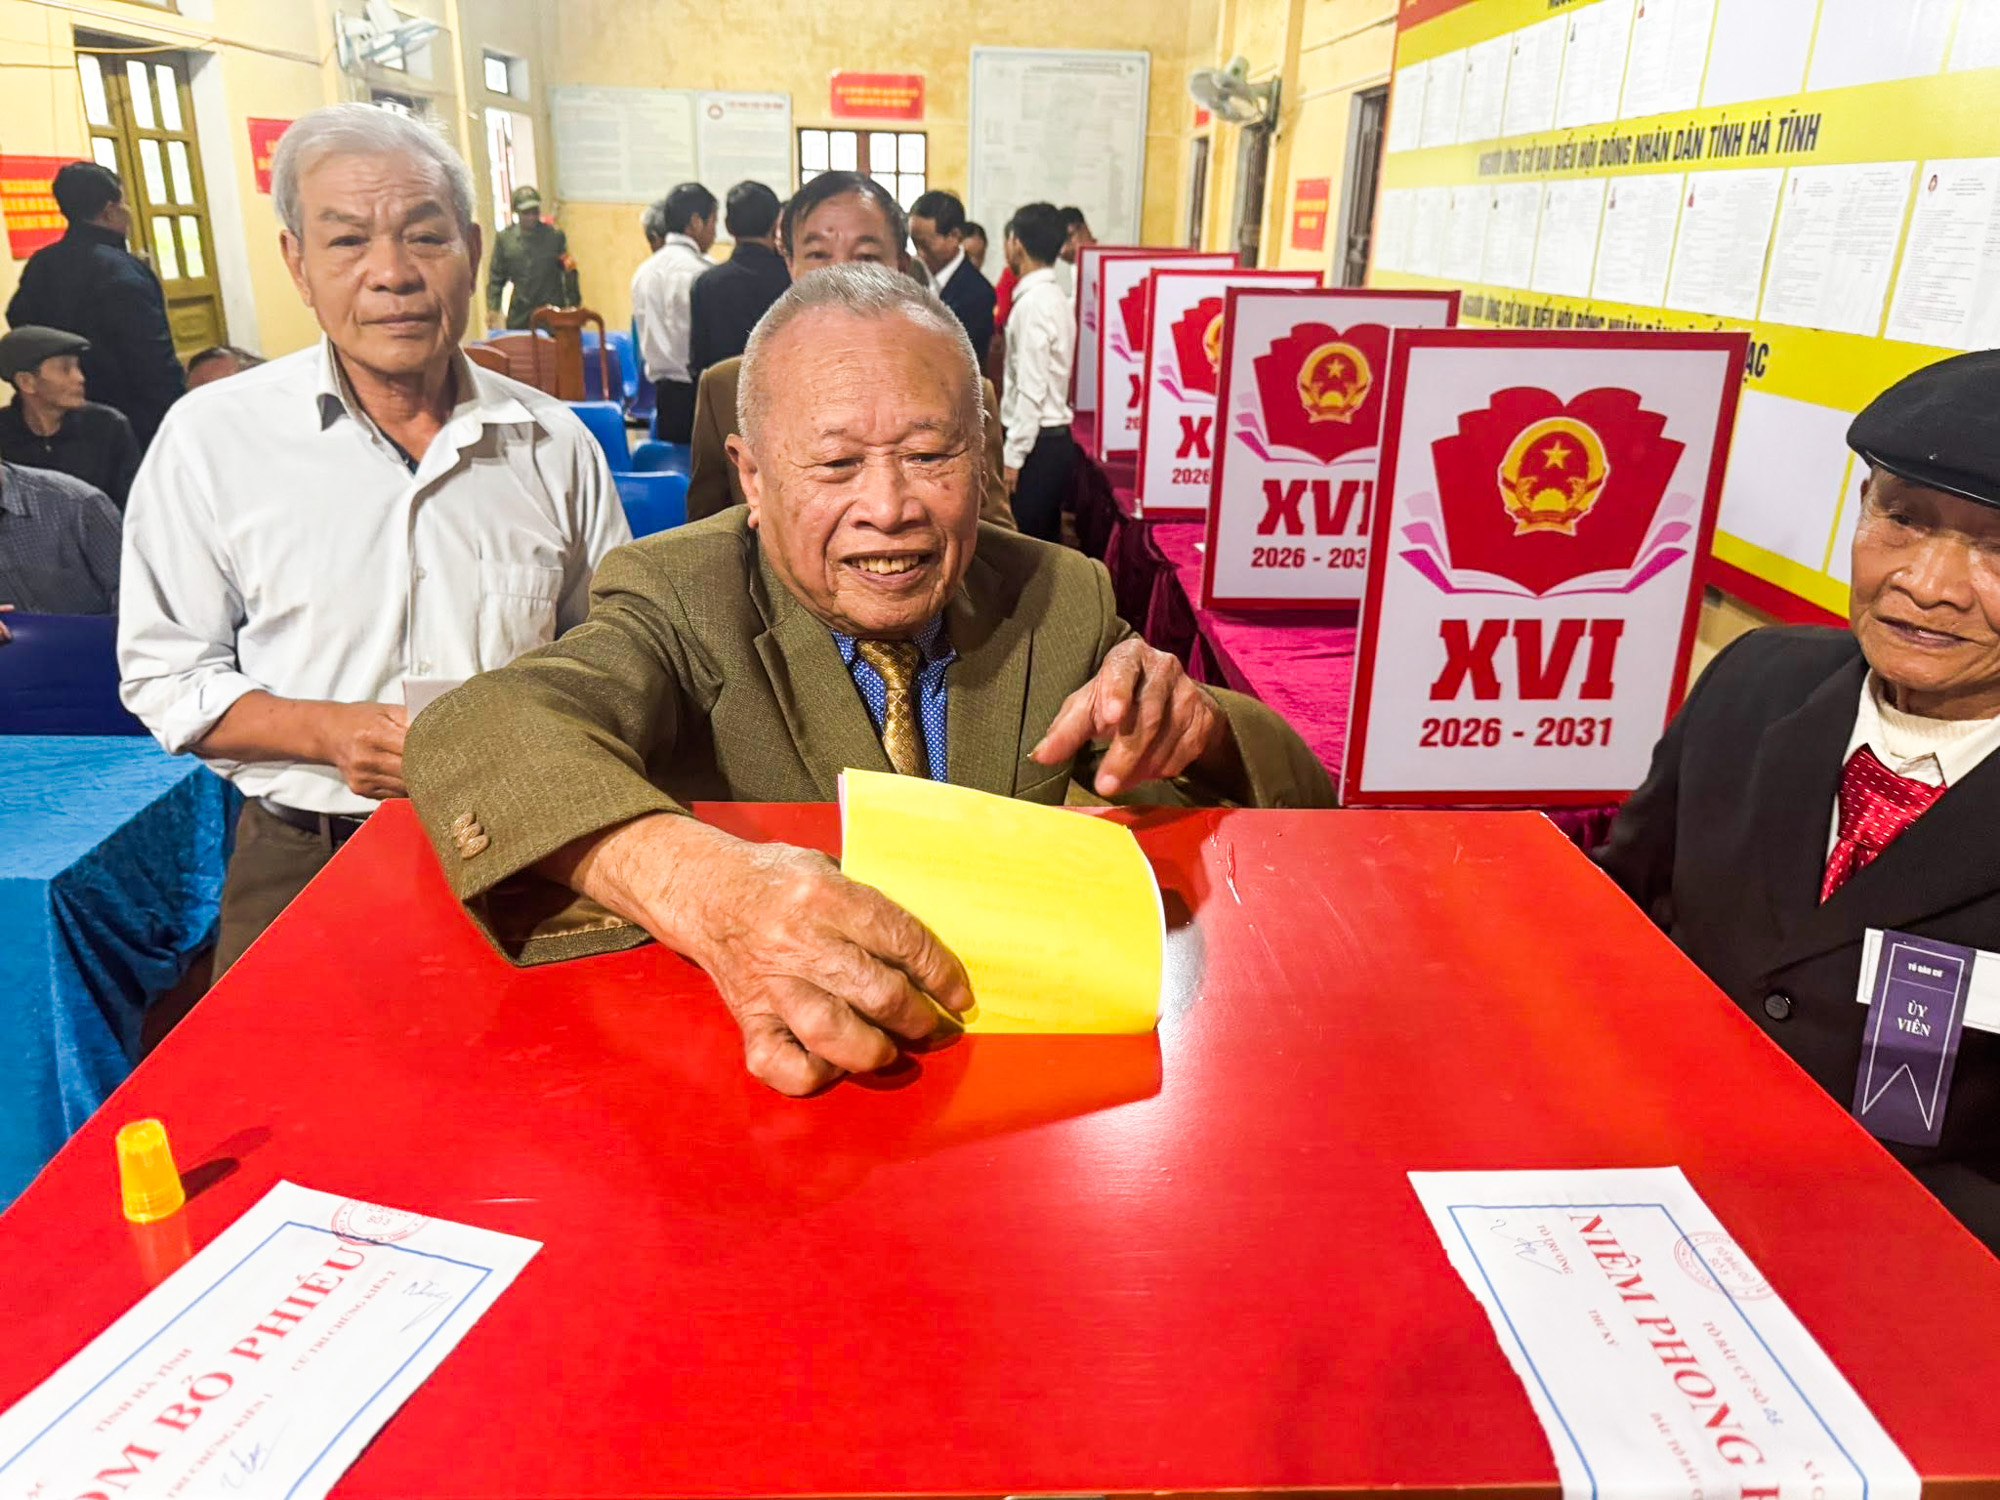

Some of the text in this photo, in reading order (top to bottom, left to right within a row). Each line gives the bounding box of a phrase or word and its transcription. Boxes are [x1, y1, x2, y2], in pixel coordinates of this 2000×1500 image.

[1633, 125, 1672, 164] NHÂN
[1673, 121, 1705, 161] DÂN
[1746, 111, 1771, 155] HÀ
[1776, 109, 1821, 153] TĨNH
[1251, 547, 1306, 568] 2026
[1328, 547, 1367, 568] 203
[1429, 619, 1625, 700] XVI
[1419, 717, 1502, 747] 2026
[1533, 716, 1613, 747] 2031
[1897, 1017, 1931, 1037] VIÊN
[1568, 1214, 1766, 1466] NIÊM PHONG
